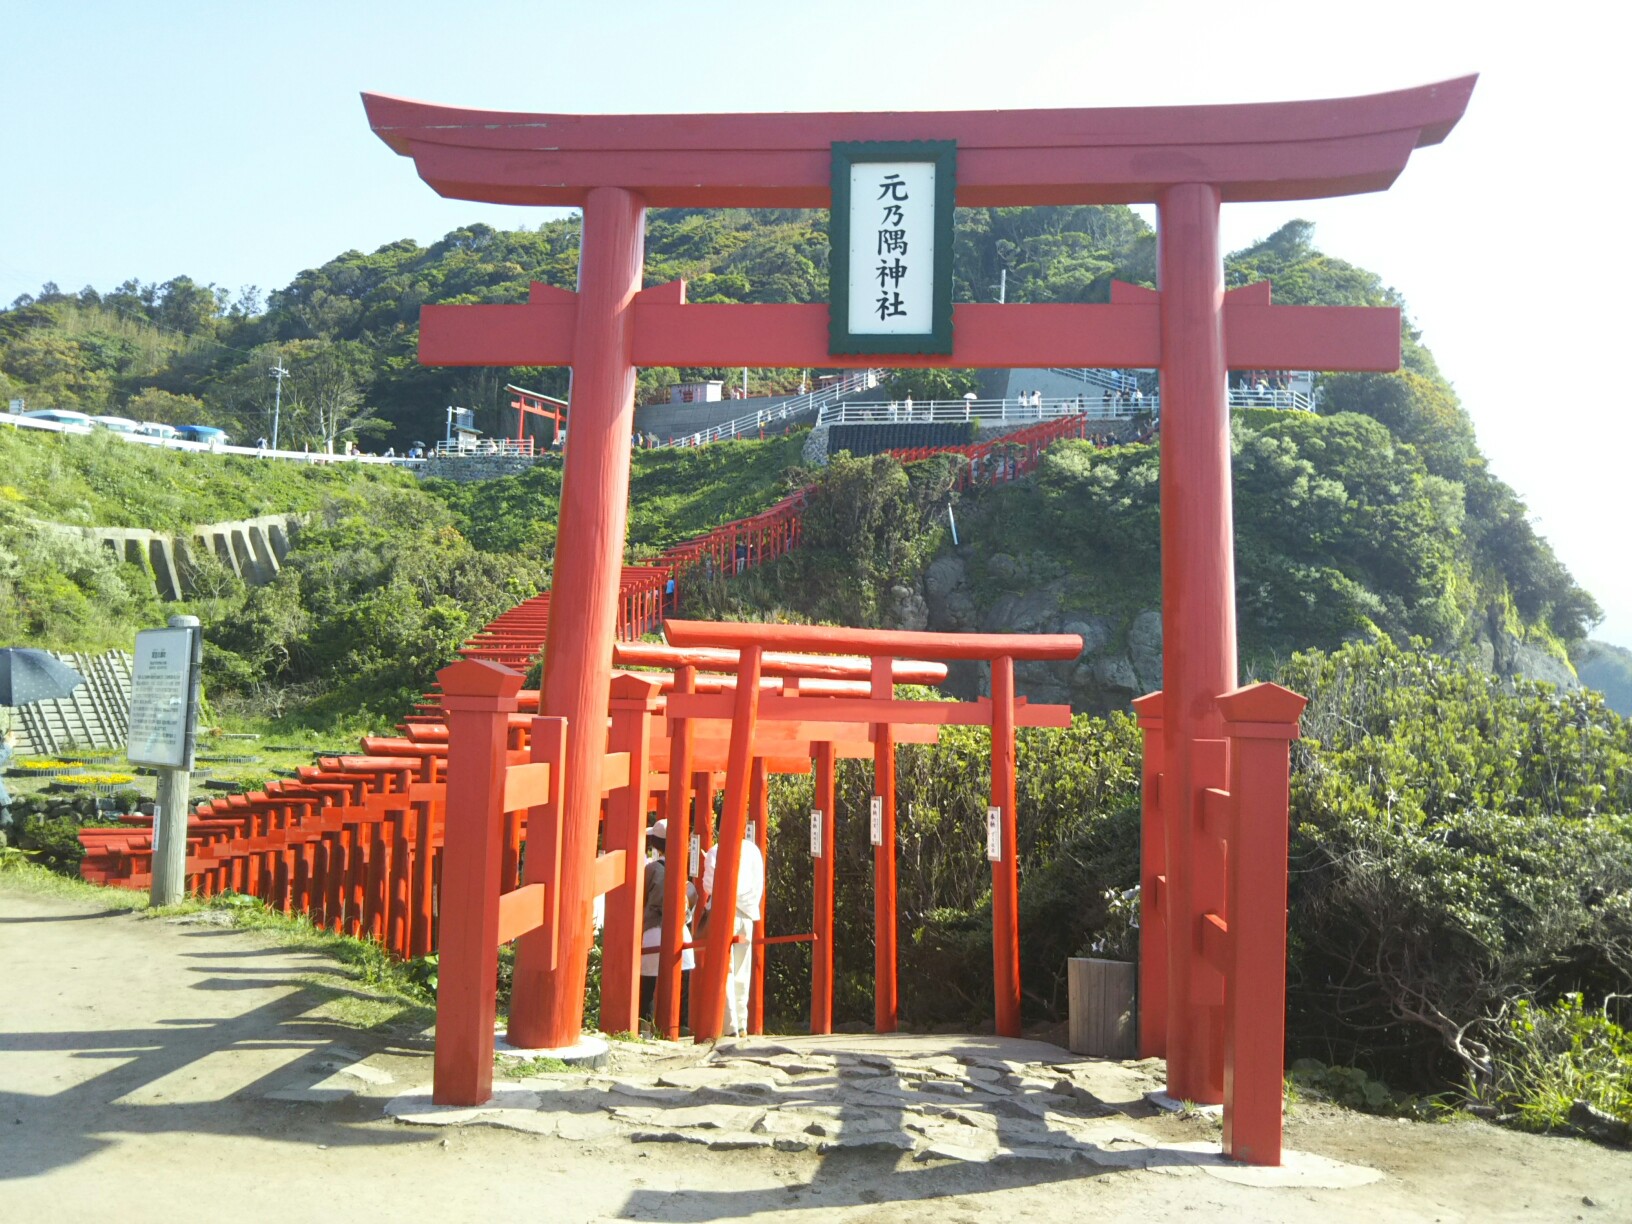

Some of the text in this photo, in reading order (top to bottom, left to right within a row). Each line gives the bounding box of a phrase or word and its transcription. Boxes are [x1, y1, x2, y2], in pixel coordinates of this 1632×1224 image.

[875, 174, 909, 321] 元乃隅神社
